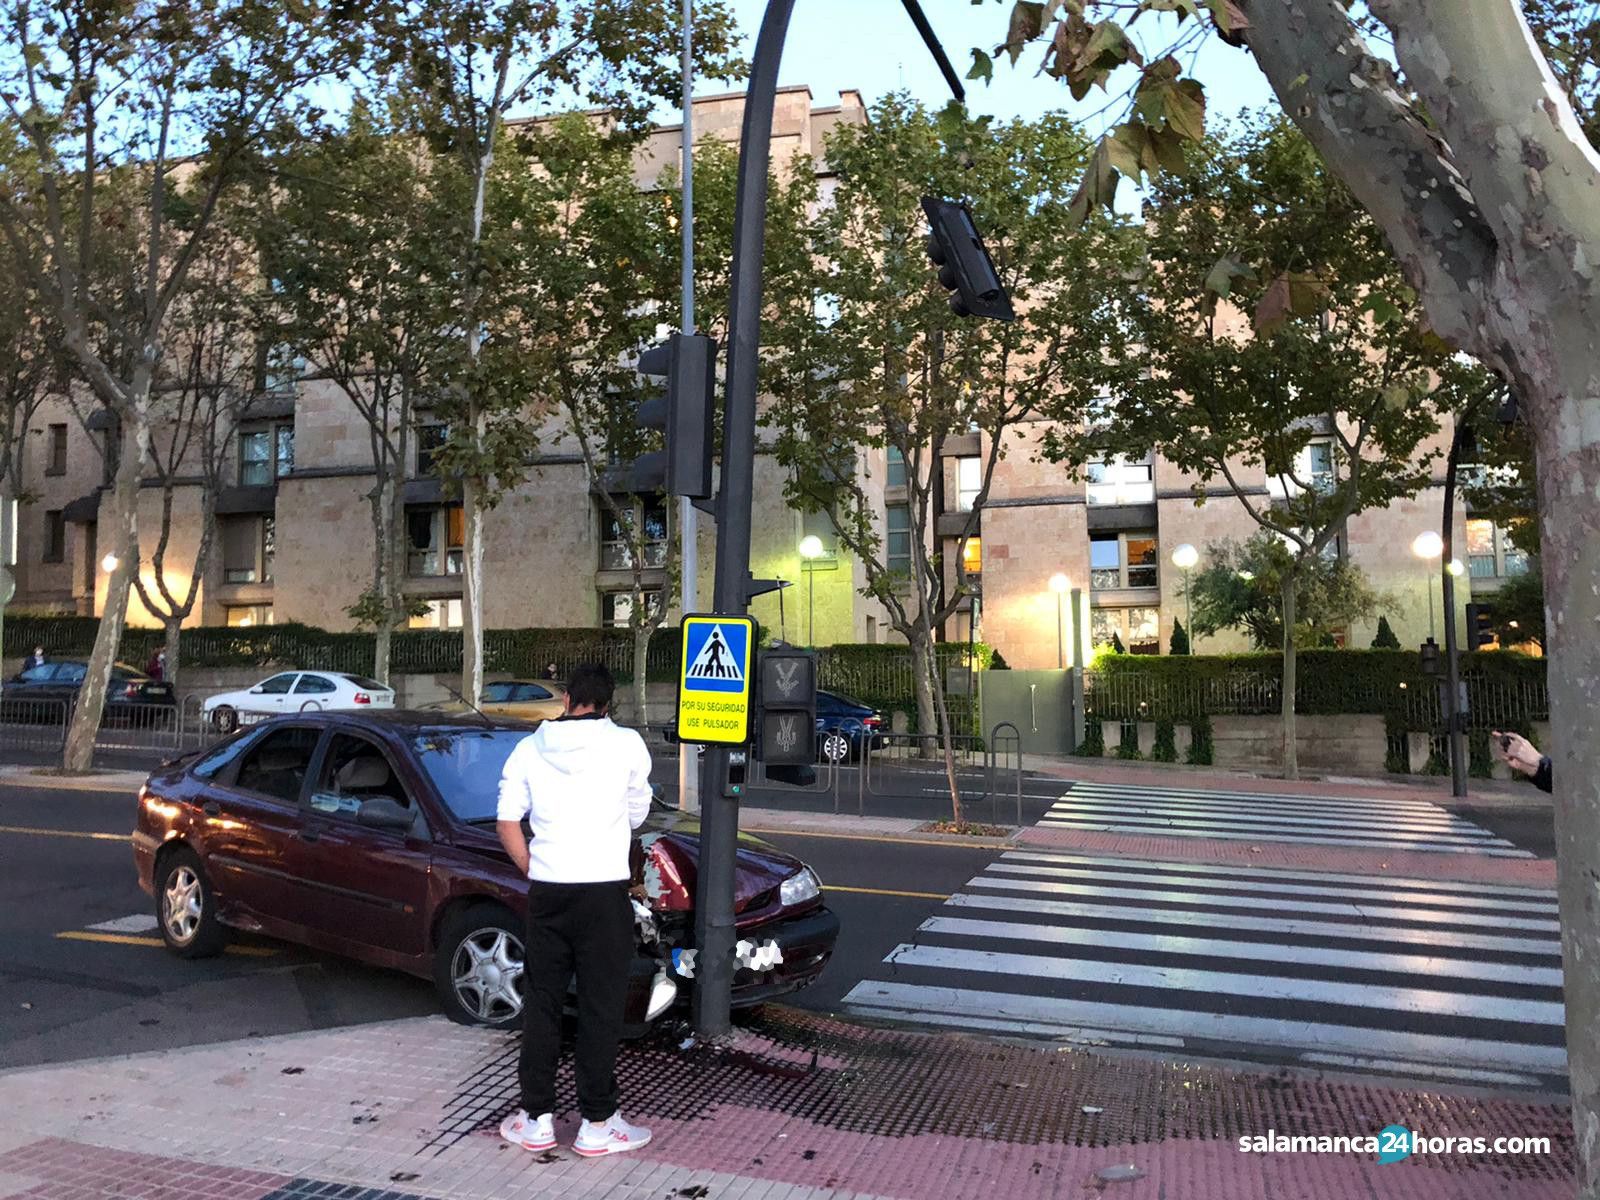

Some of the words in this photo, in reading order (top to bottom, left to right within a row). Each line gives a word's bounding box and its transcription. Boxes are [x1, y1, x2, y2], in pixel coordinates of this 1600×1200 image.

[681, 700, 696, 710] POR
[696, 701, 706, 711] SU
[706, 702, 746, 713] SEGURIDAD
[686, 717, 700, 727] USE
[703, 719, 739, 729] PULSADOR
[608, 1128, 628, 1142] FILA
